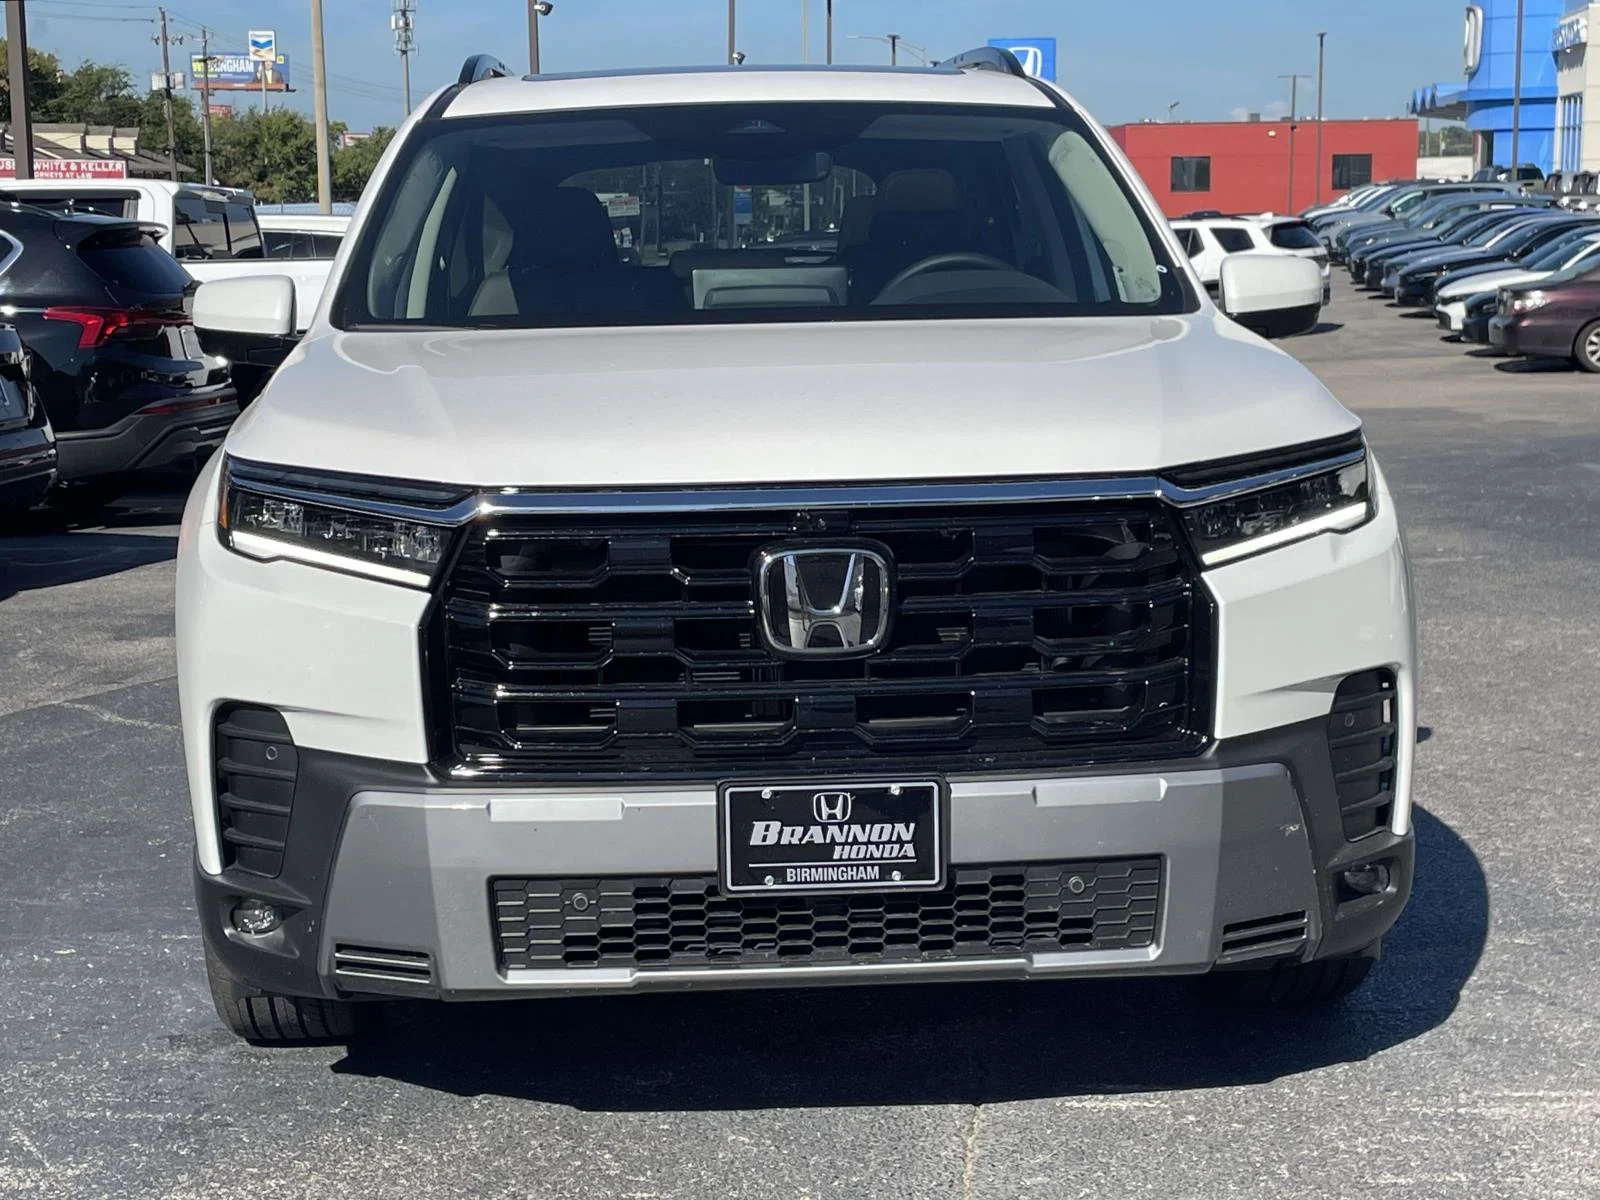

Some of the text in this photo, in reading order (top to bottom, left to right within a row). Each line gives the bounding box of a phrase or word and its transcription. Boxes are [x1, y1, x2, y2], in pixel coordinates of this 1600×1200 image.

[34, 161, 67, 171] WHITE
[70, 162, 77, 171] &
[80, 162, 122, 172] KELLER
[34, 171, 93, 179] ORNEYS AT LAW
[750, 821, 916, 846] BRANNON
[832, 843, 916, 860] HONDA
[786, 865, 880, 883] BIRMINGHAM
